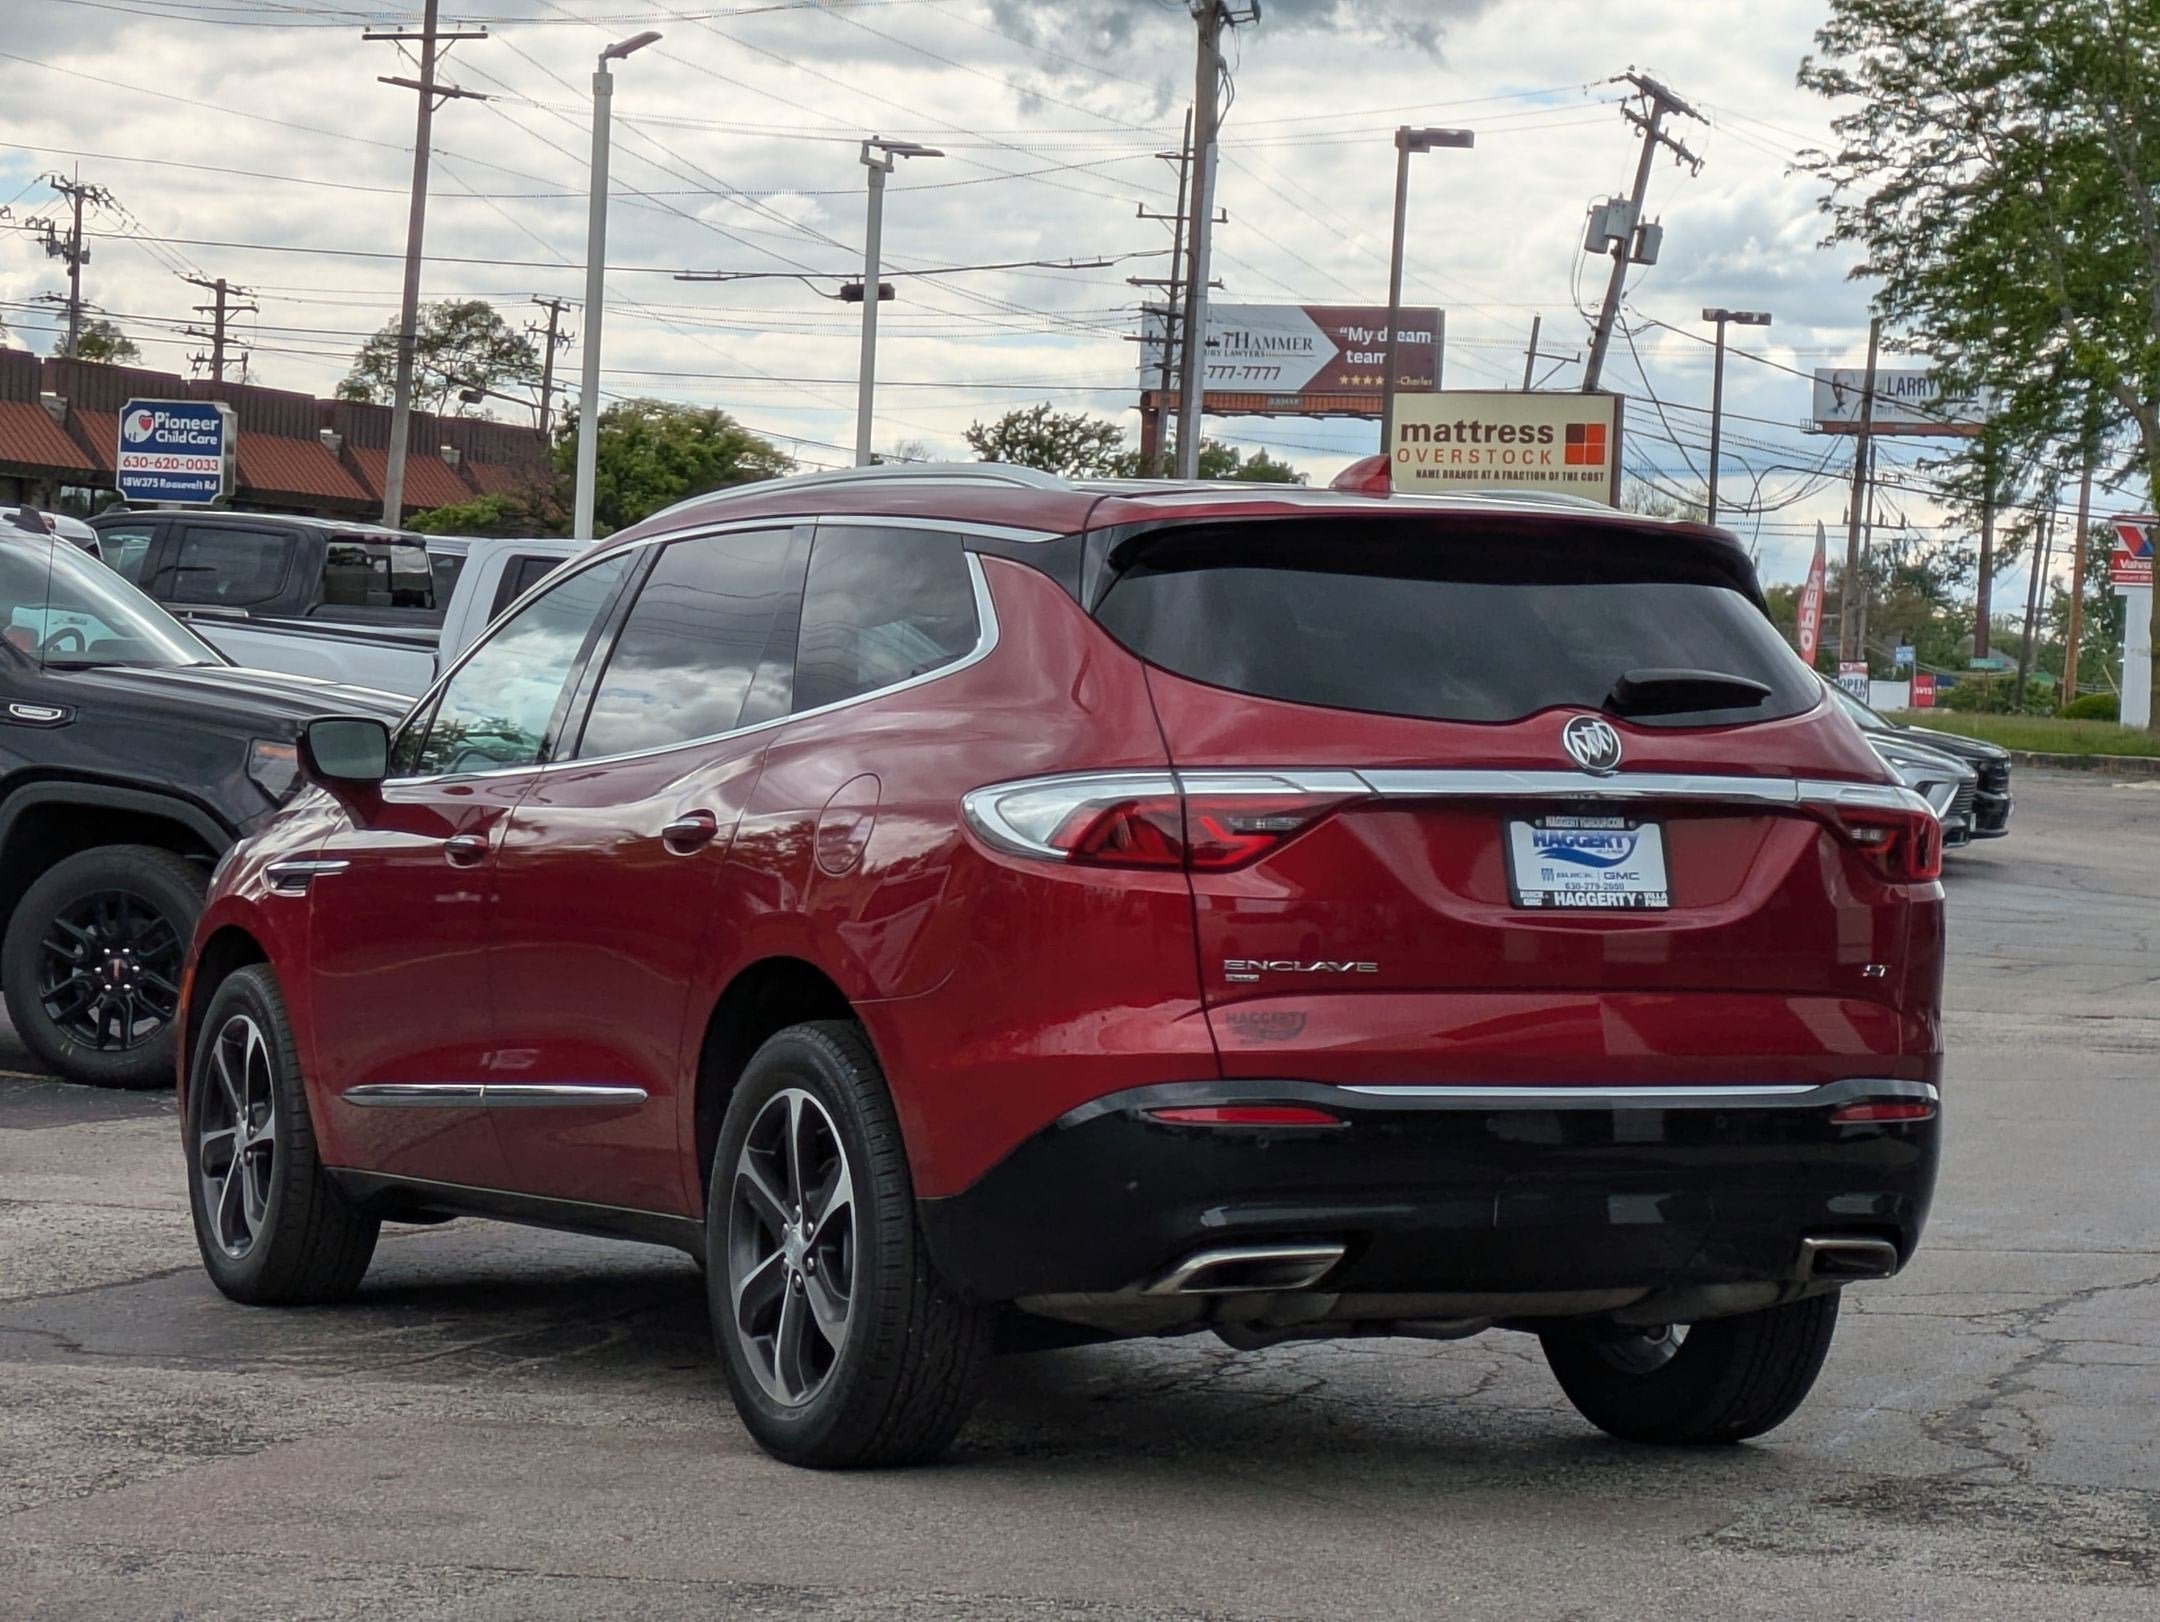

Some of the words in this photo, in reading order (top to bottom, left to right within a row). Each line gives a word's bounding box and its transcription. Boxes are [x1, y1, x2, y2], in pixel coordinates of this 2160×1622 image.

[1377, 326, 1432, 344] deam
[1224, 350, 1265, 358] LAWYERS
[1887, 376, 1936, 396] LARRY
[154, 412, 219, 431] Pioneer
[155, 430, 187, 443] Child
[188, 432, 217, 445] Care
[1401, 419, 1554, 444] mattress
[123, 456, 218, 471] 630-620-0033
[1397, 448, 1552, 465] OVERSTOCK
[1416, 469, 1440, 479] NAME
[1442, 469, 1479, 480] BRANDS
[1481, 470, 1491, 480] AT
[1494, 470, 1500, 480] A
[1502, 470, 1546, 480] FRACTION
[1548, 471, 1560, 480] OF
[1562, 471, 1578, 481] THE
[1580, 471, 1604, 481] COST
[160, 479, 203, 491] Roosevelt
[204, 480, 217, 491] Rd
[1801, 570, 1821, 652] OPEN
[1838, 678, 1867, 690] OPEN
[1532, 829, 1640, 849] HAGGERTY
[1603, 871, 1640, 880] GMC
[1554, 891, 1637, 906] HAGGERTY
[1224, 959, 1378, 972] ENCLAVE
